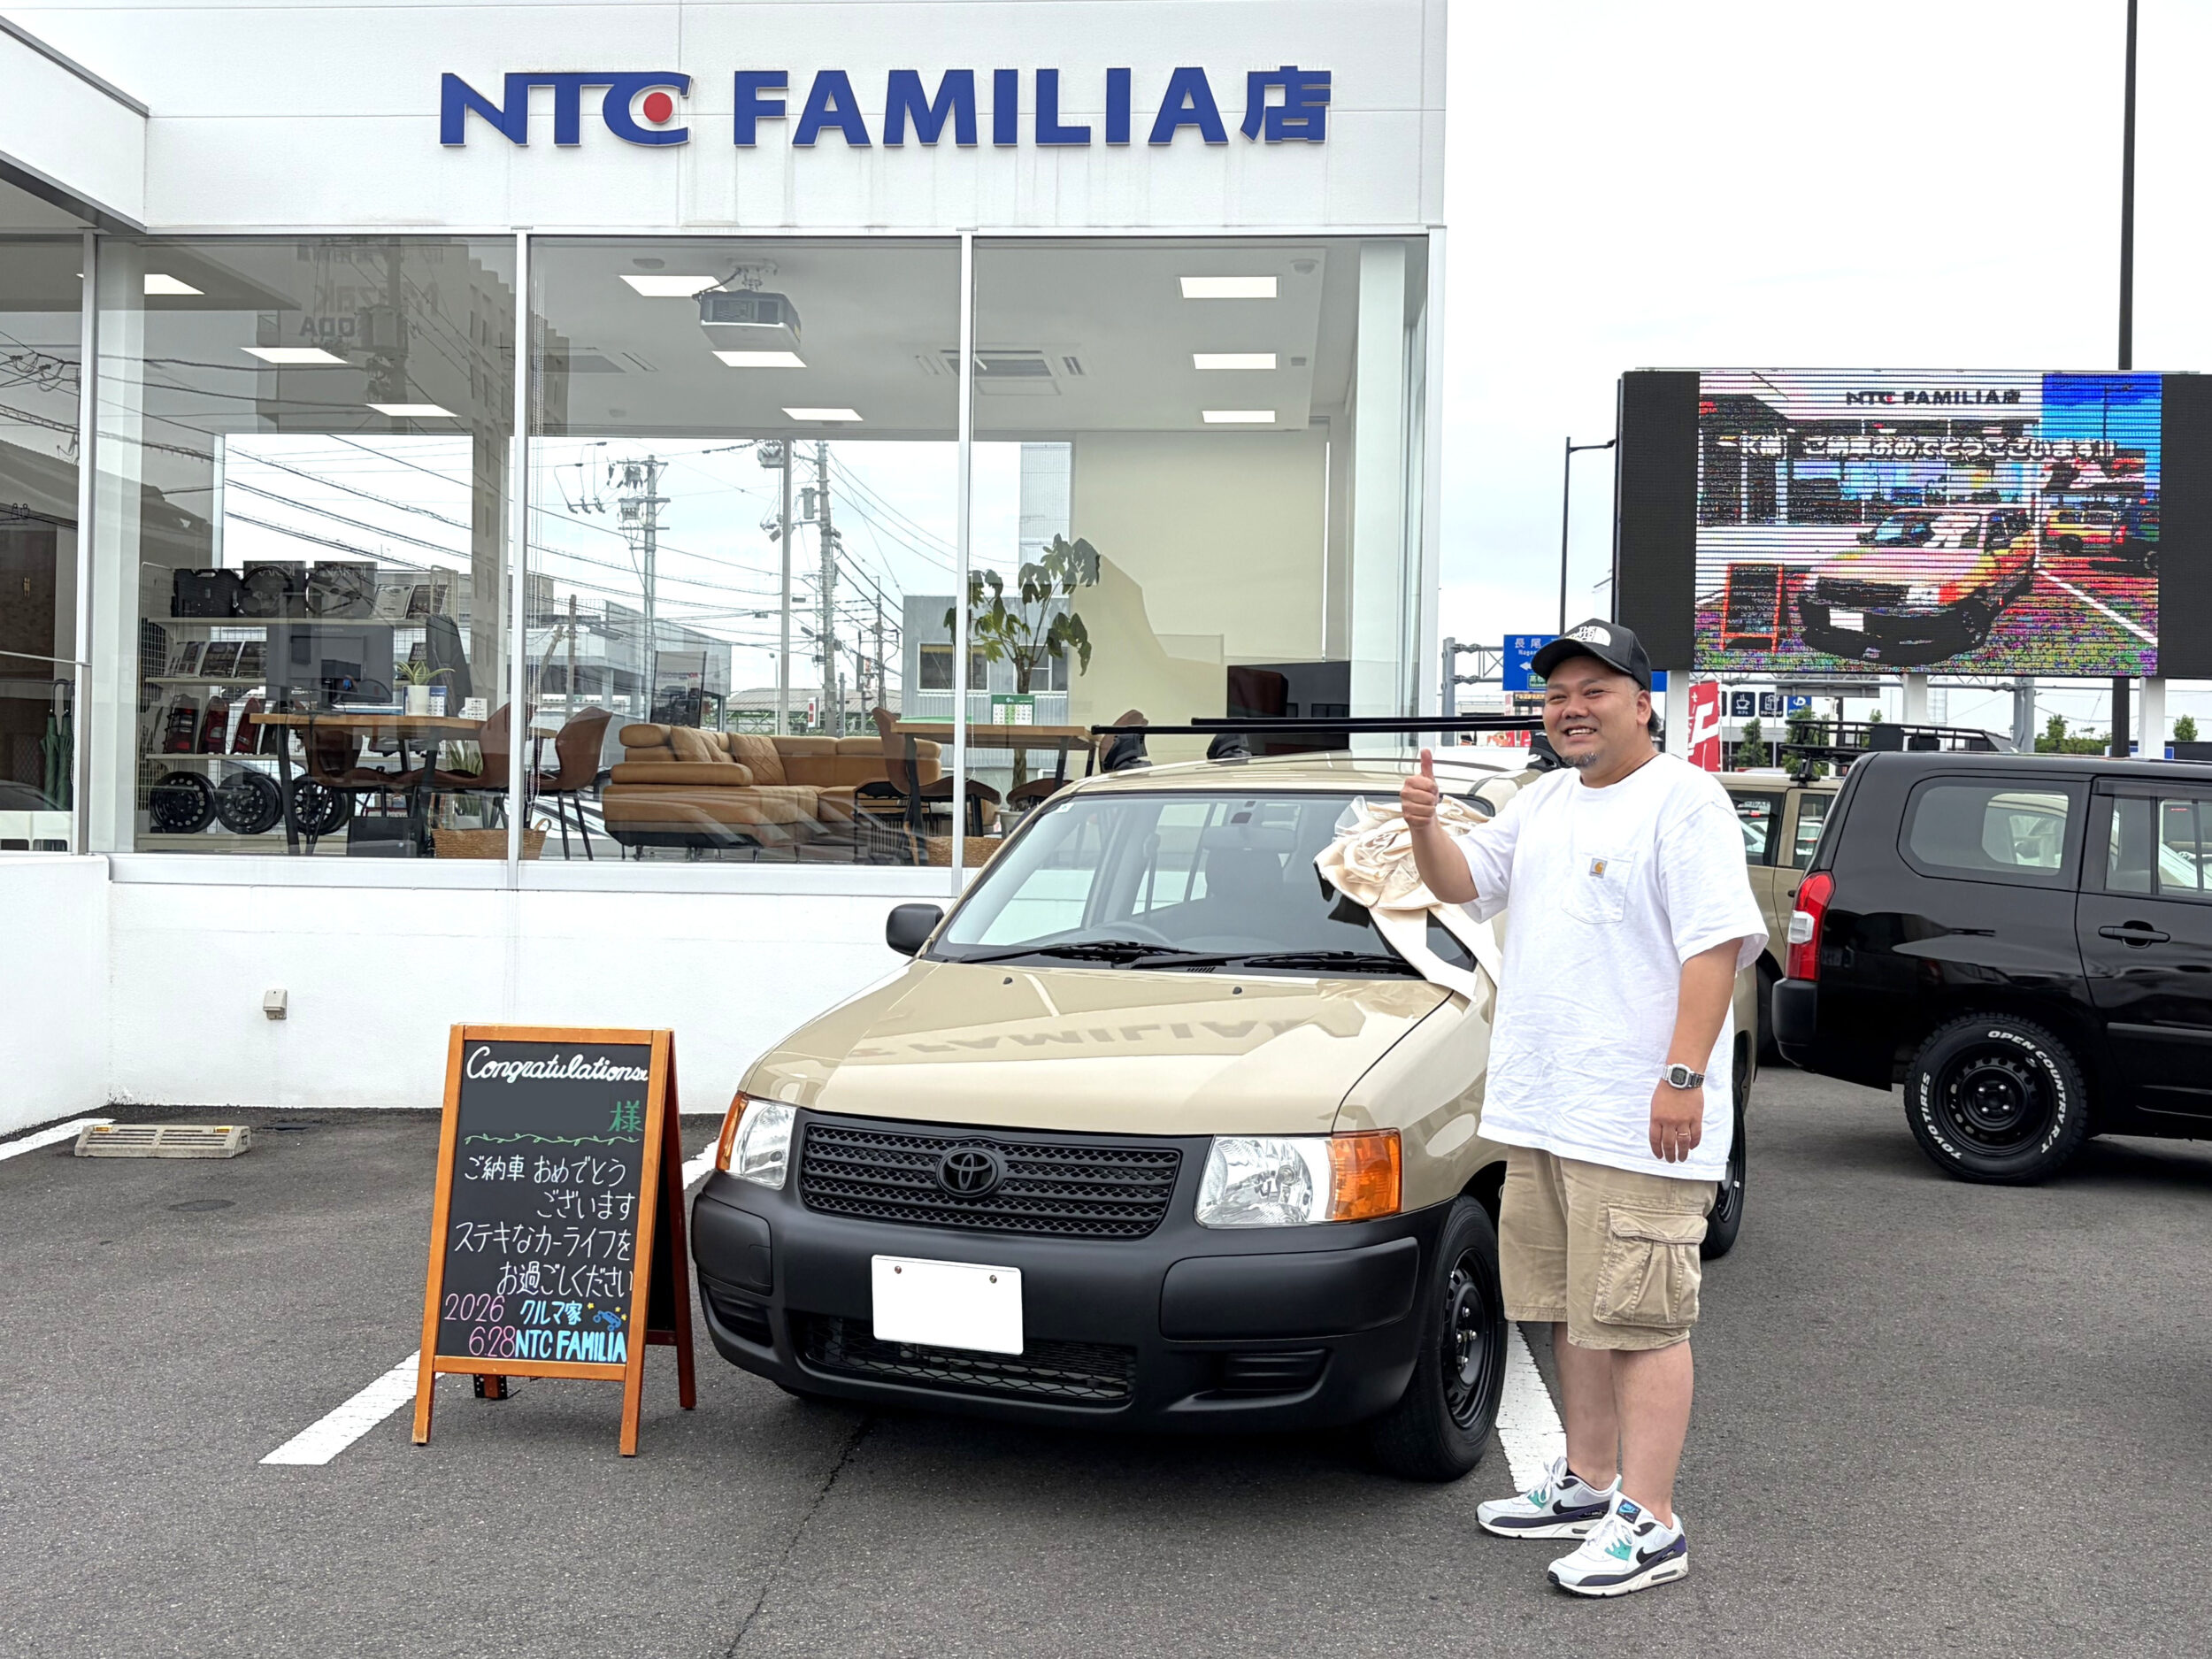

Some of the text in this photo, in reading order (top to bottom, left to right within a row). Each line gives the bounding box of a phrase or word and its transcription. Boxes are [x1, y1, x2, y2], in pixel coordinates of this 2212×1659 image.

[440, 71, 692, 148] NTC
[1988, 1030, 2067, 1154] OPEN COUNTRY R/T
[606, 1100, 644, 1133] 様
[1919, 1071, 1962, 1160] TOYO TIRES
[465, 1154, 626, 1187] ご納車 おめでとう
[536, 1189, 636, 1221] ございます
[454, 1221, 632, 1261] ステキなカーライフを
[496, 1261, 634, 1298] お過ごしください
[444, 1293, 505, 1323] 2026
[519, 1300, 583, 1325] クルマ家
[514, 1329, 627, 1363] NTC FAMILIA
